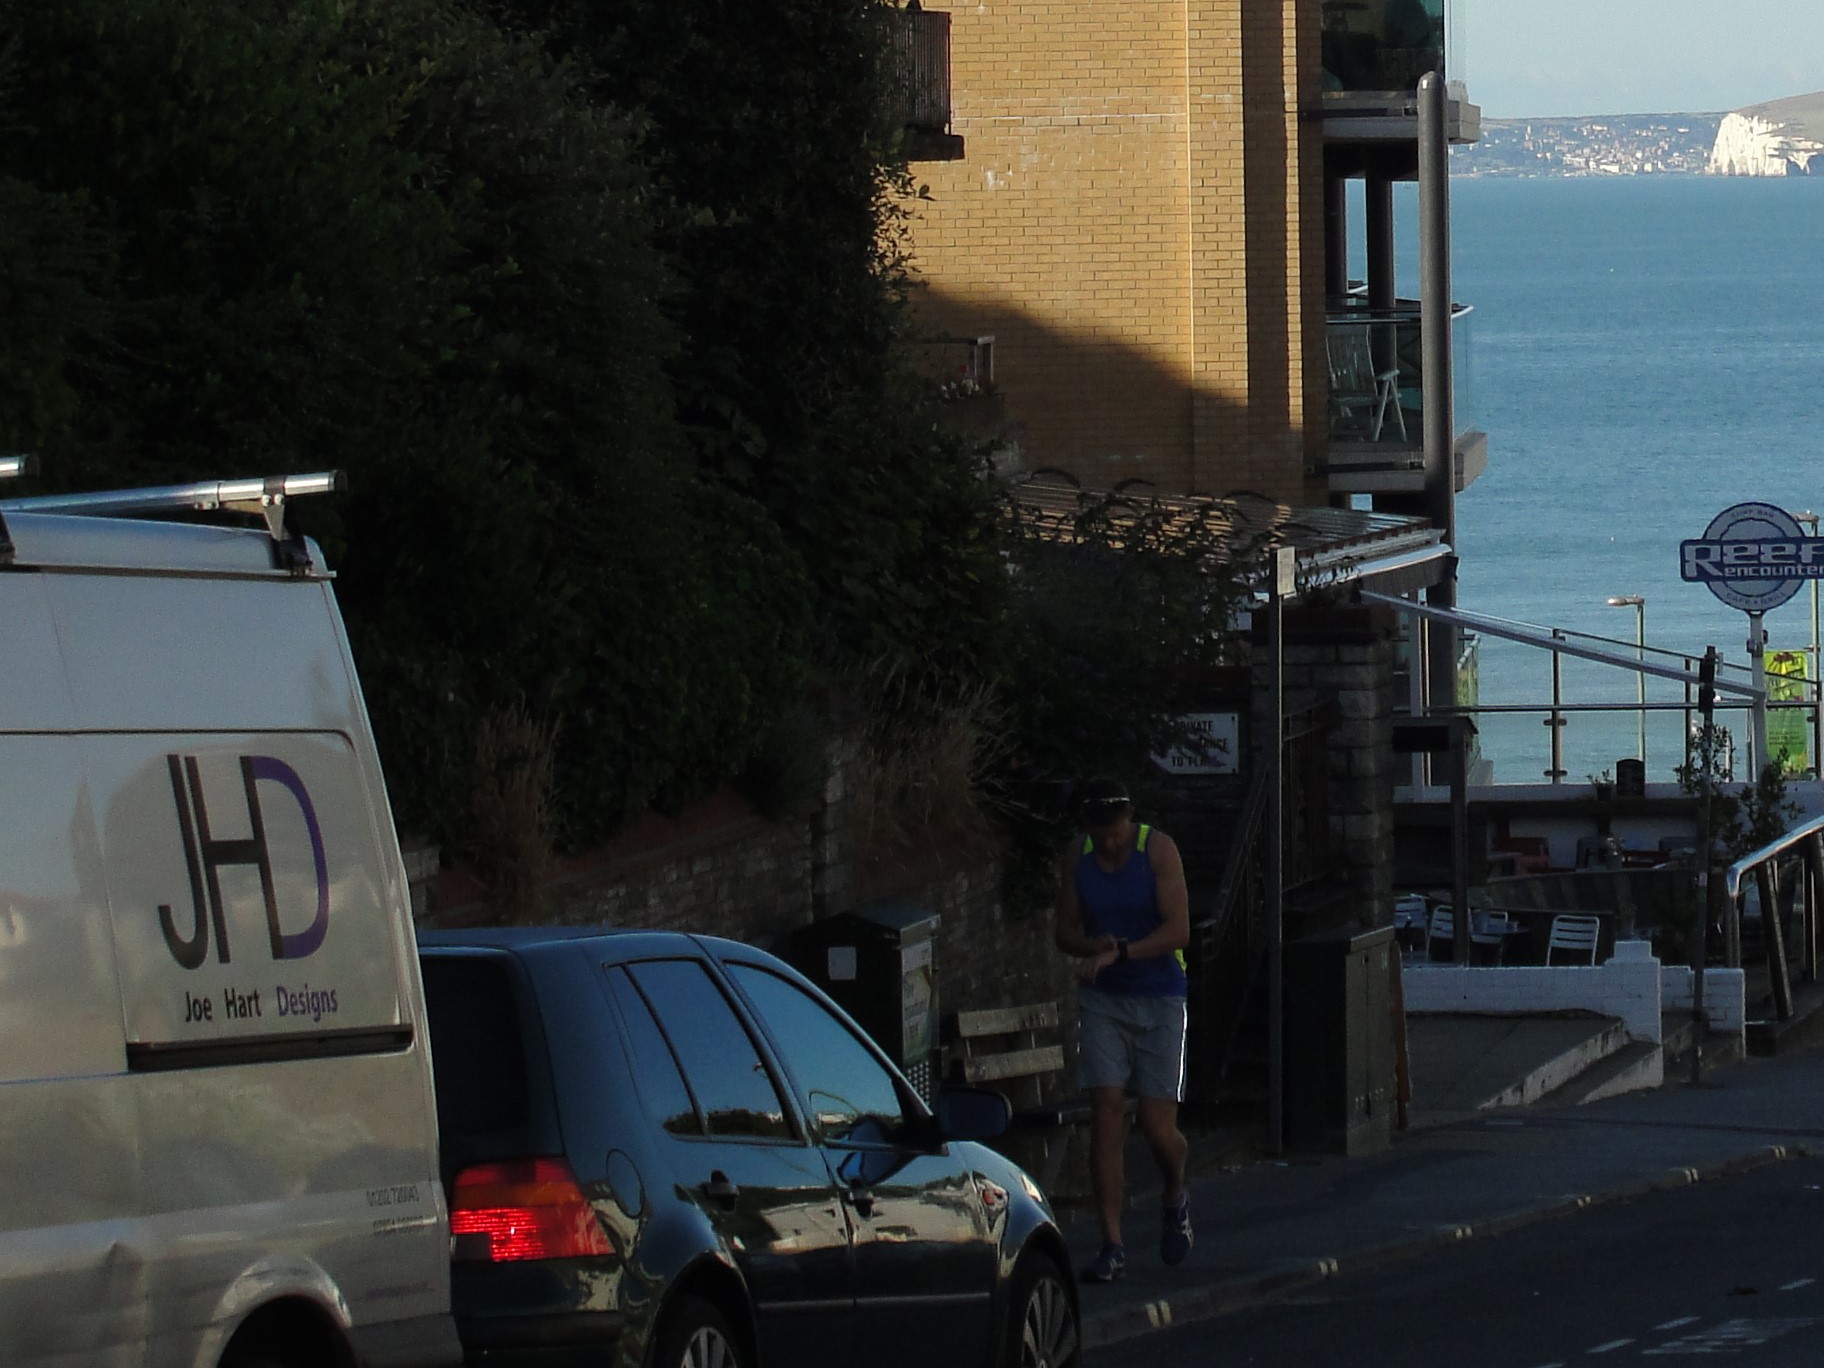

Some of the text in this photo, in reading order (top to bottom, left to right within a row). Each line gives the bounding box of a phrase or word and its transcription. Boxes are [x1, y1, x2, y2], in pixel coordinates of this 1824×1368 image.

[157, 753, 330, 971] JHD
[184, 982, 339, 1023] Joe Hart Designs
